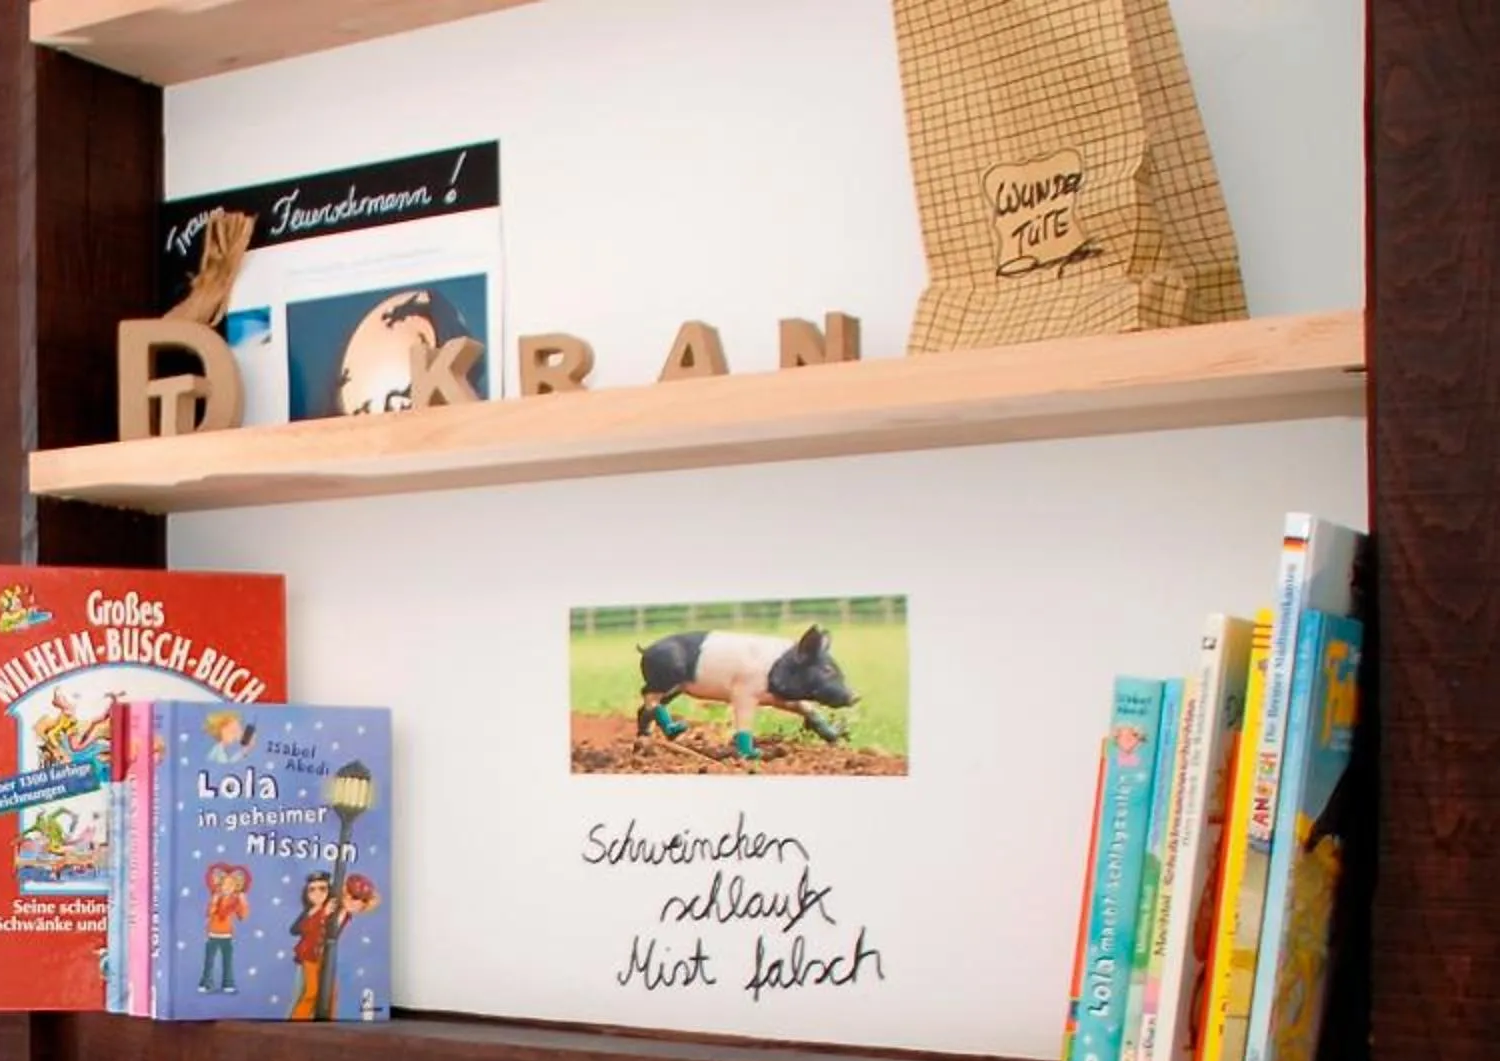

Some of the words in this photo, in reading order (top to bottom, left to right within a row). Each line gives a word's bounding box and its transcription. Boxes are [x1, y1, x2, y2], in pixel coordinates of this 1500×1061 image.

[87, 590, 164, 627] Großes
[198, 768, 279, 800] Lola
[199, 808, 218, 828] in
[225, 806, 327, 831] geheimer
[246, 831, 358, 863] Mission
[582, 811, 810, 865] Schweinchen
[13, 900, 56, 914] Seine
[59, 899, 109, 914] schön
[77, 916, 108, 932] und
[617, 936, 716, 991] Mist
